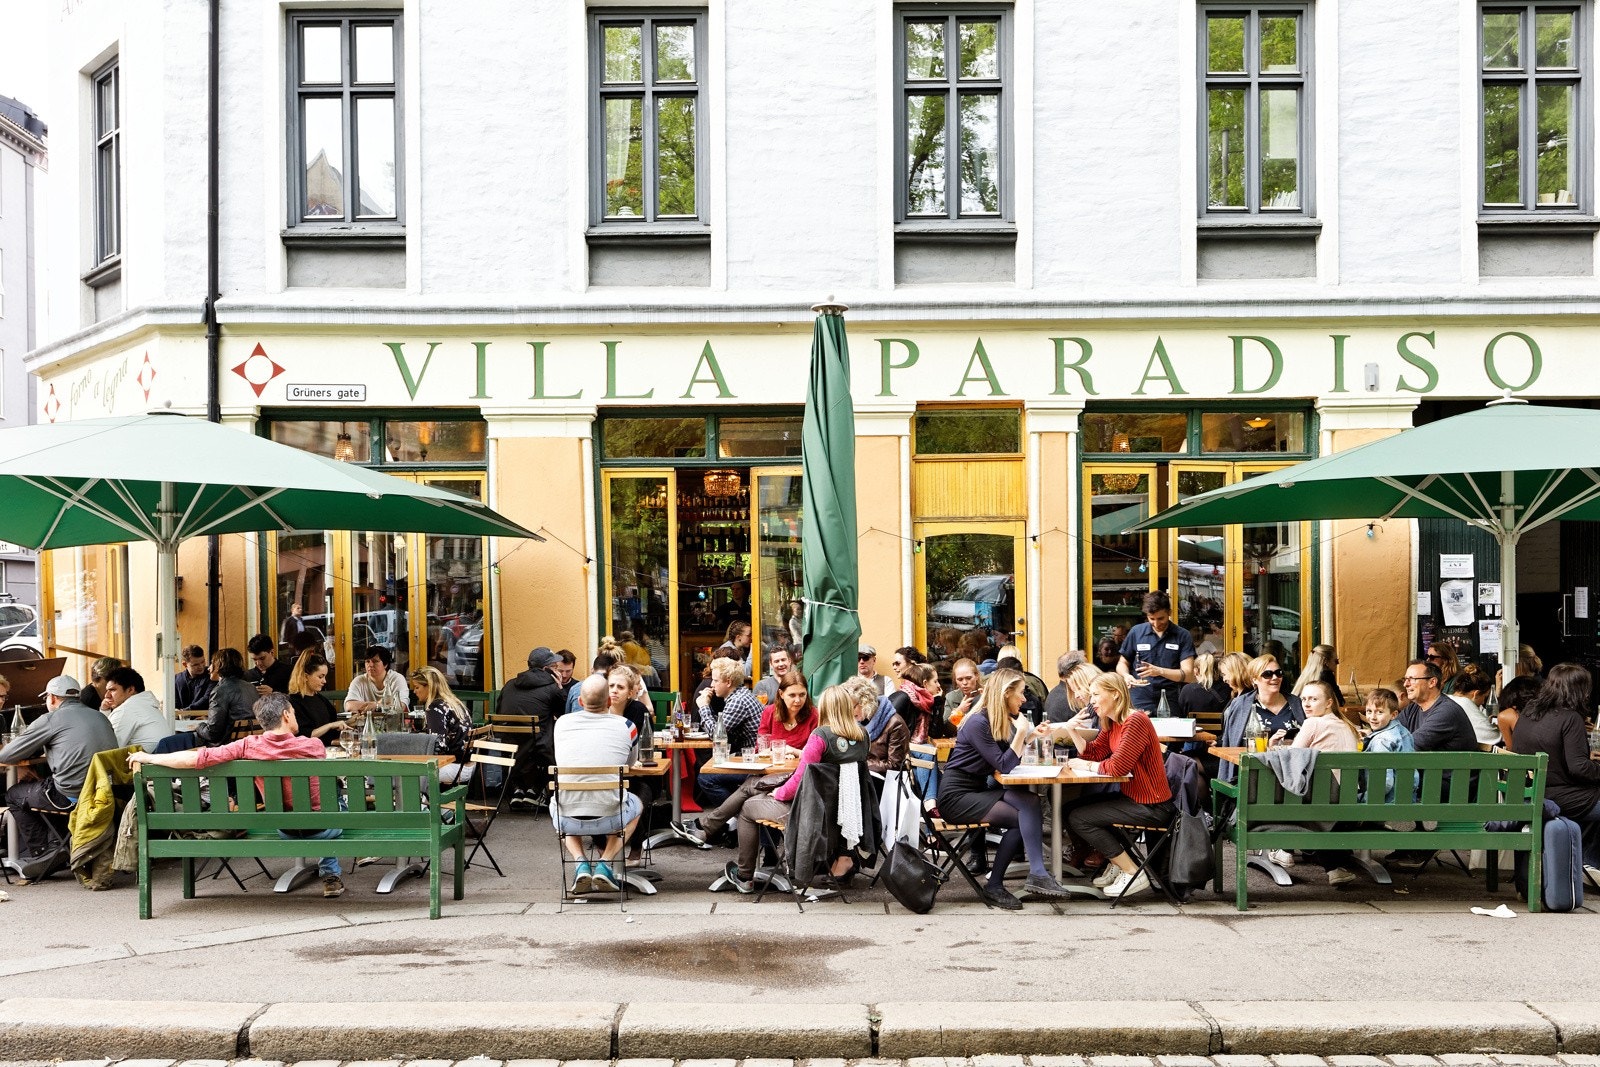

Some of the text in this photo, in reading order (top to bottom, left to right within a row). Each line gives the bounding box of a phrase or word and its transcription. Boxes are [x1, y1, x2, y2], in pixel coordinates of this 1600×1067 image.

[382, 330, 1543, 401] VILLA PARADISO
[293, 387, 360, 399] Grüners gate
